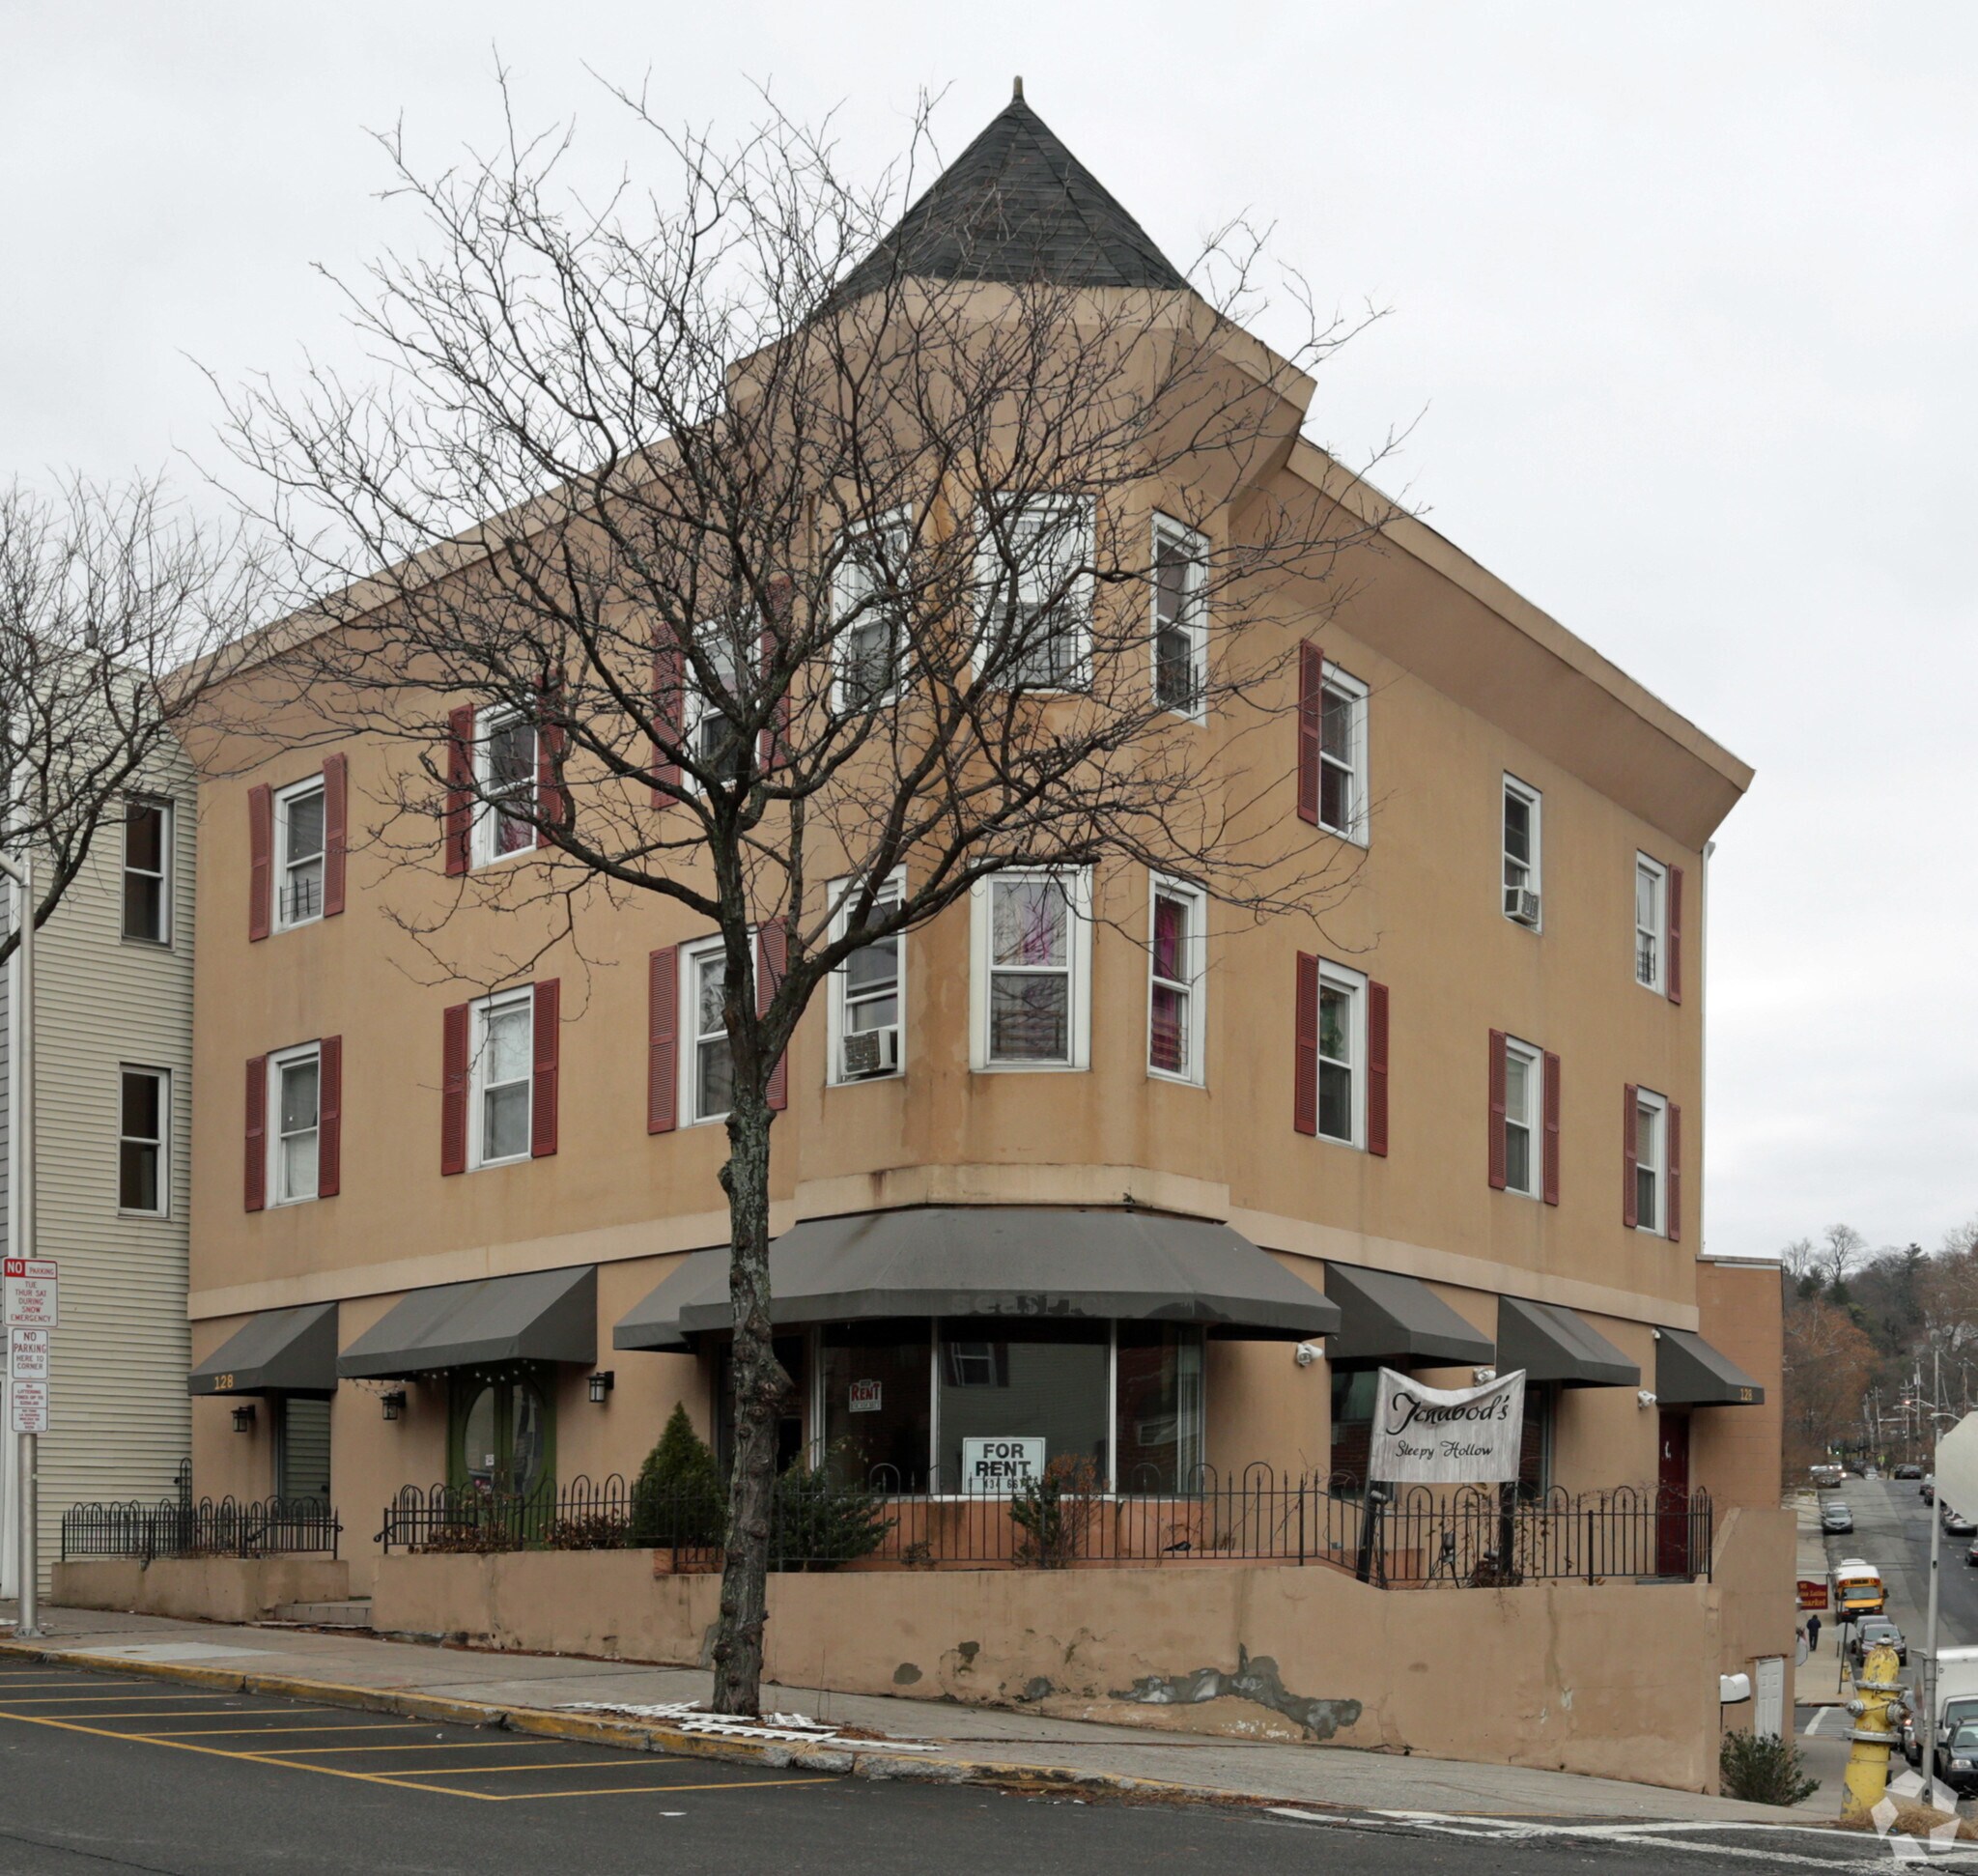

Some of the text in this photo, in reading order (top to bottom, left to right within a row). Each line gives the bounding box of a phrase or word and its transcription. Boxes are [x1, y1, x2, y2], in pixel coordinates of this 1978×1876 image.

[7, 1261, 55, 1275] NO PARKING
[18, 1297, 43, 1306] DURING
[21, 1305, 42, 1314] SNOW
[11, 1314, 51, 1322] EMERGENCY
[23, 1331, 37, 1342] NO
[14, 1343, 47, 1353] PARKING
[214, 1374, 234, 1390] 128
[983, 1443, 1025, 1459] FOR
[1396, 1440, 1493, 1460] Sleepy Hollow
[975, 1461, 1031, 1477] RENT
